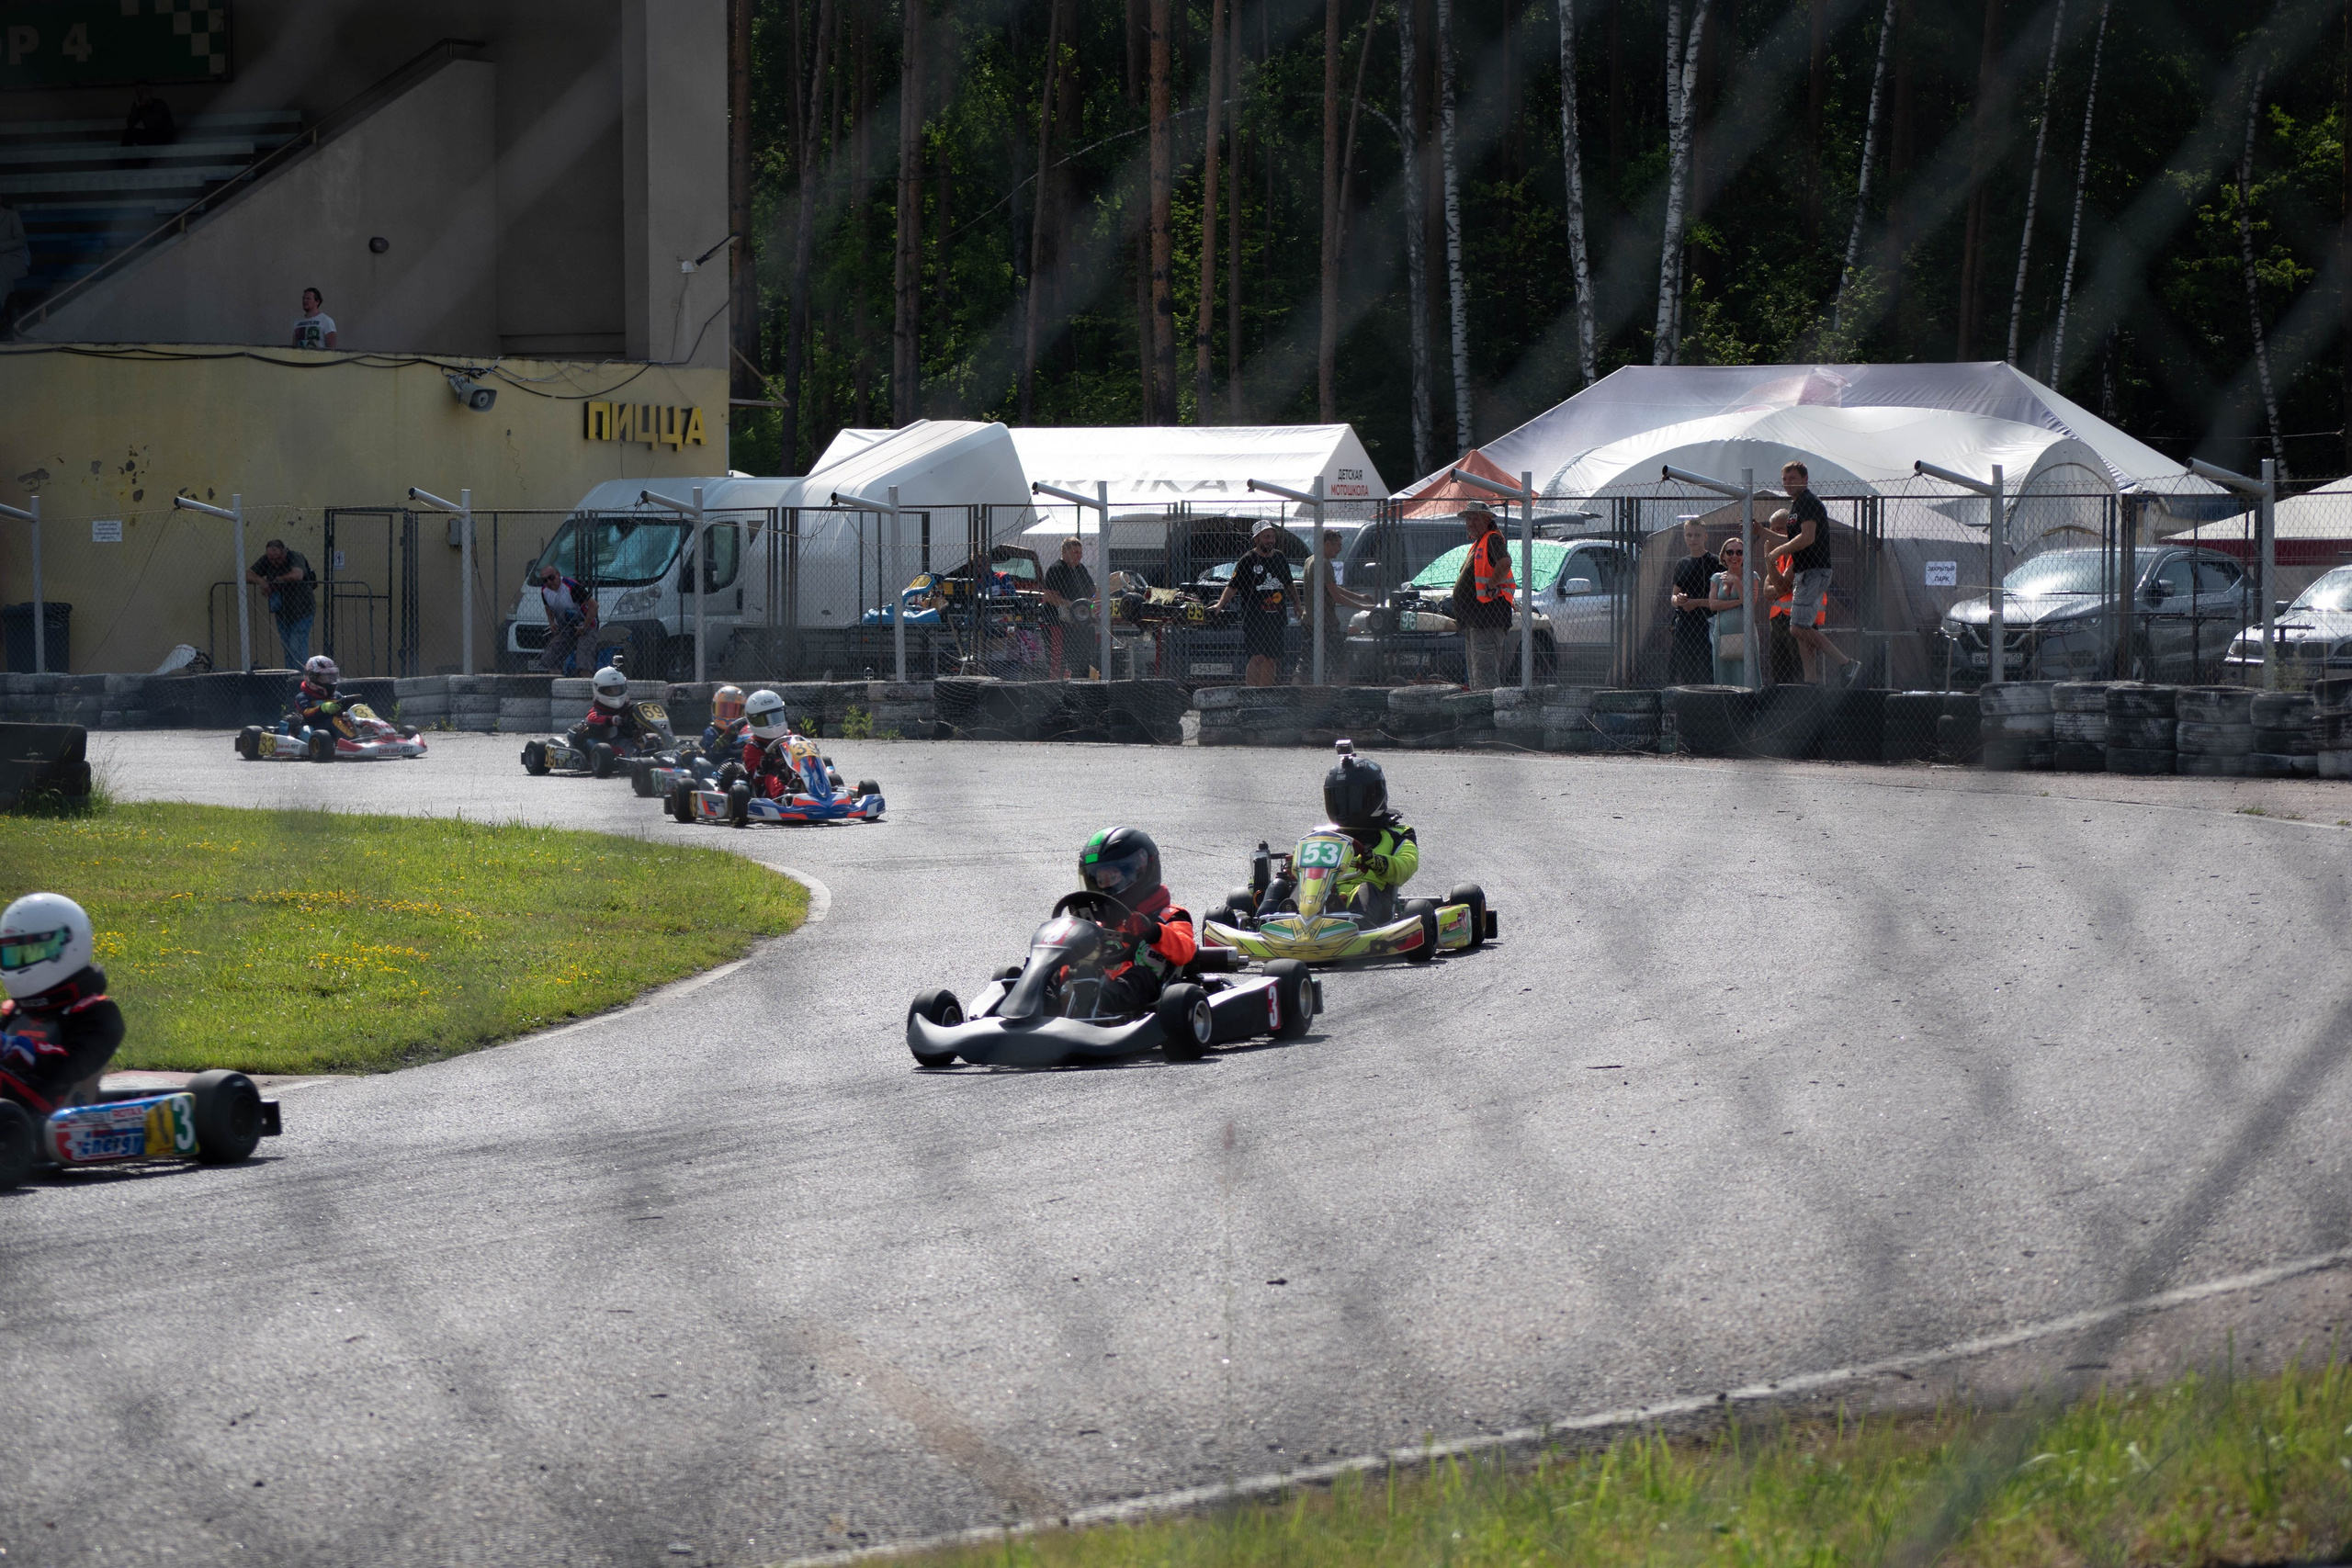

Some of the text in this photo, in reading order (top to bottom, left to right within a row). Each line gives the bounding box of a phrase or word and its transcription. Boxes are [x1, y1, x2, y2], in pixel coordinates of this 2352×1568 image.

[0, 23, 92, 65] P 4
[584, 401, 707, 451] ПИЦЦА
[1338, 469, 1363, 480] ДЕТСКАЯ
[1330, 484, 1369, 496] МОТОШКОЛА
[1189, 603, 1204, 618] 95
[1401, 612, 1416, 629] 96
[641, 705, 664, 717] 69
[260, 737, 275, 753] 33
[378, 746, 413, 754] birelART
[1303, 842, 1339, 864] 53
[1268, 986, 1278, 1027] 3
[172, 1096, 195, 1150] 3
